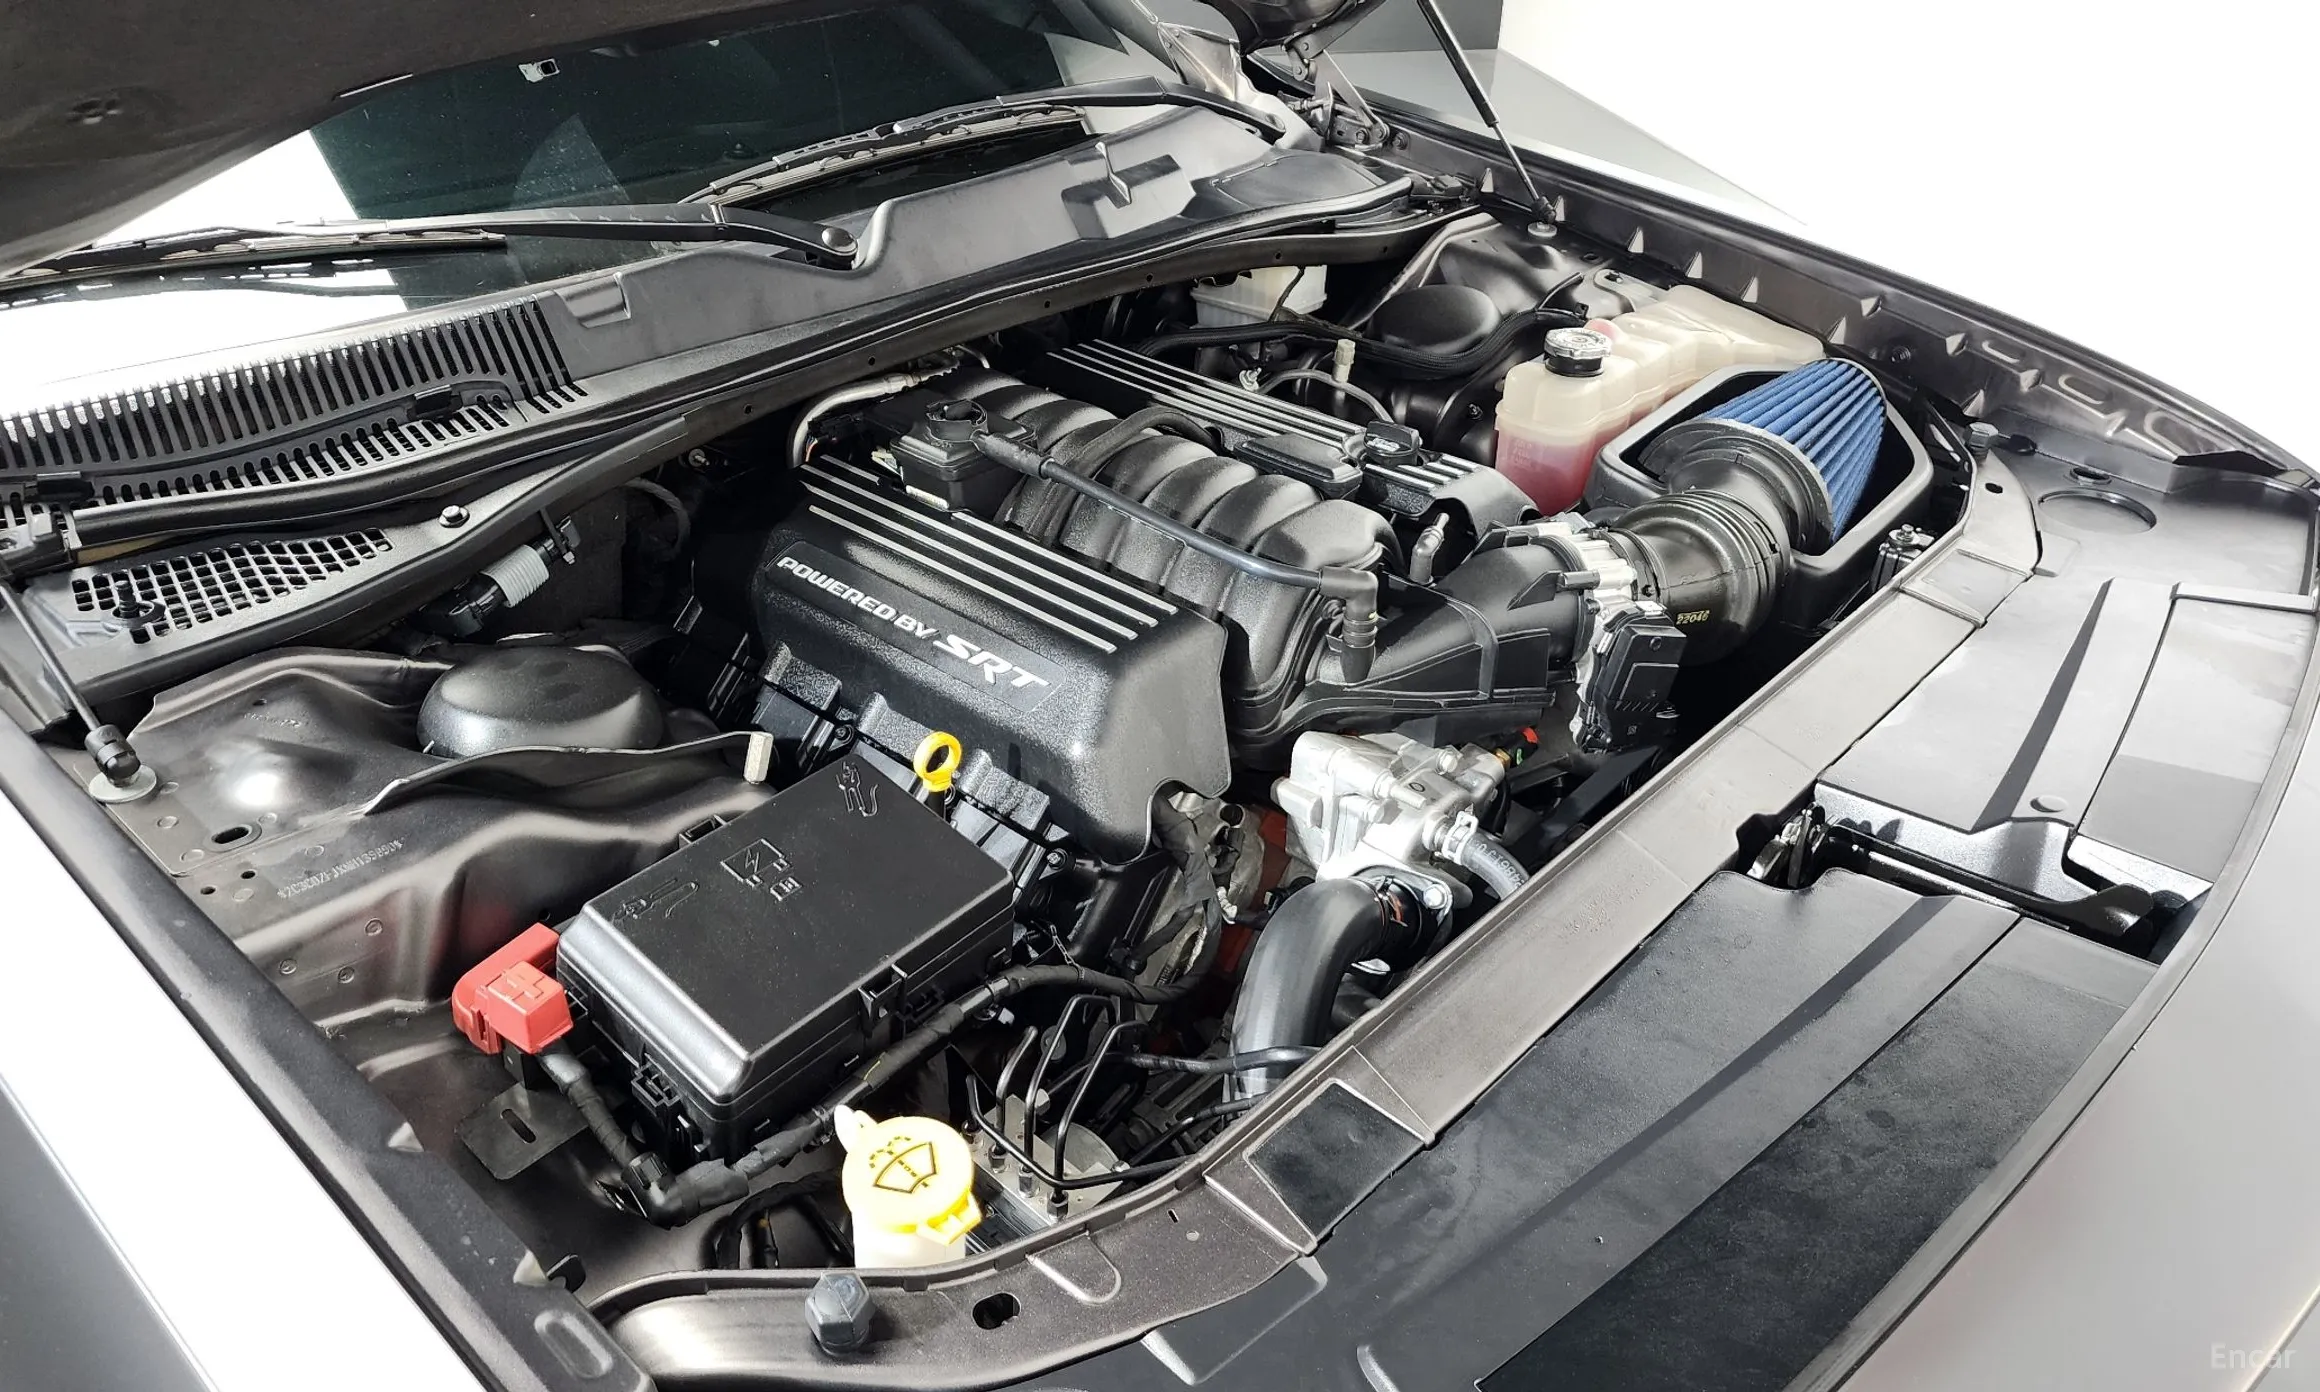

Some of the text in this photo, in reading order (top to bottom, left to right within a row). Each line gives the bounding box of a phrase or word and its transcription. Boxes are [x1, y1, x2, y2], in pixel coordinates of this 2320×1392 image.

[777, 556, 1051, 688] POWERED BY SRT
